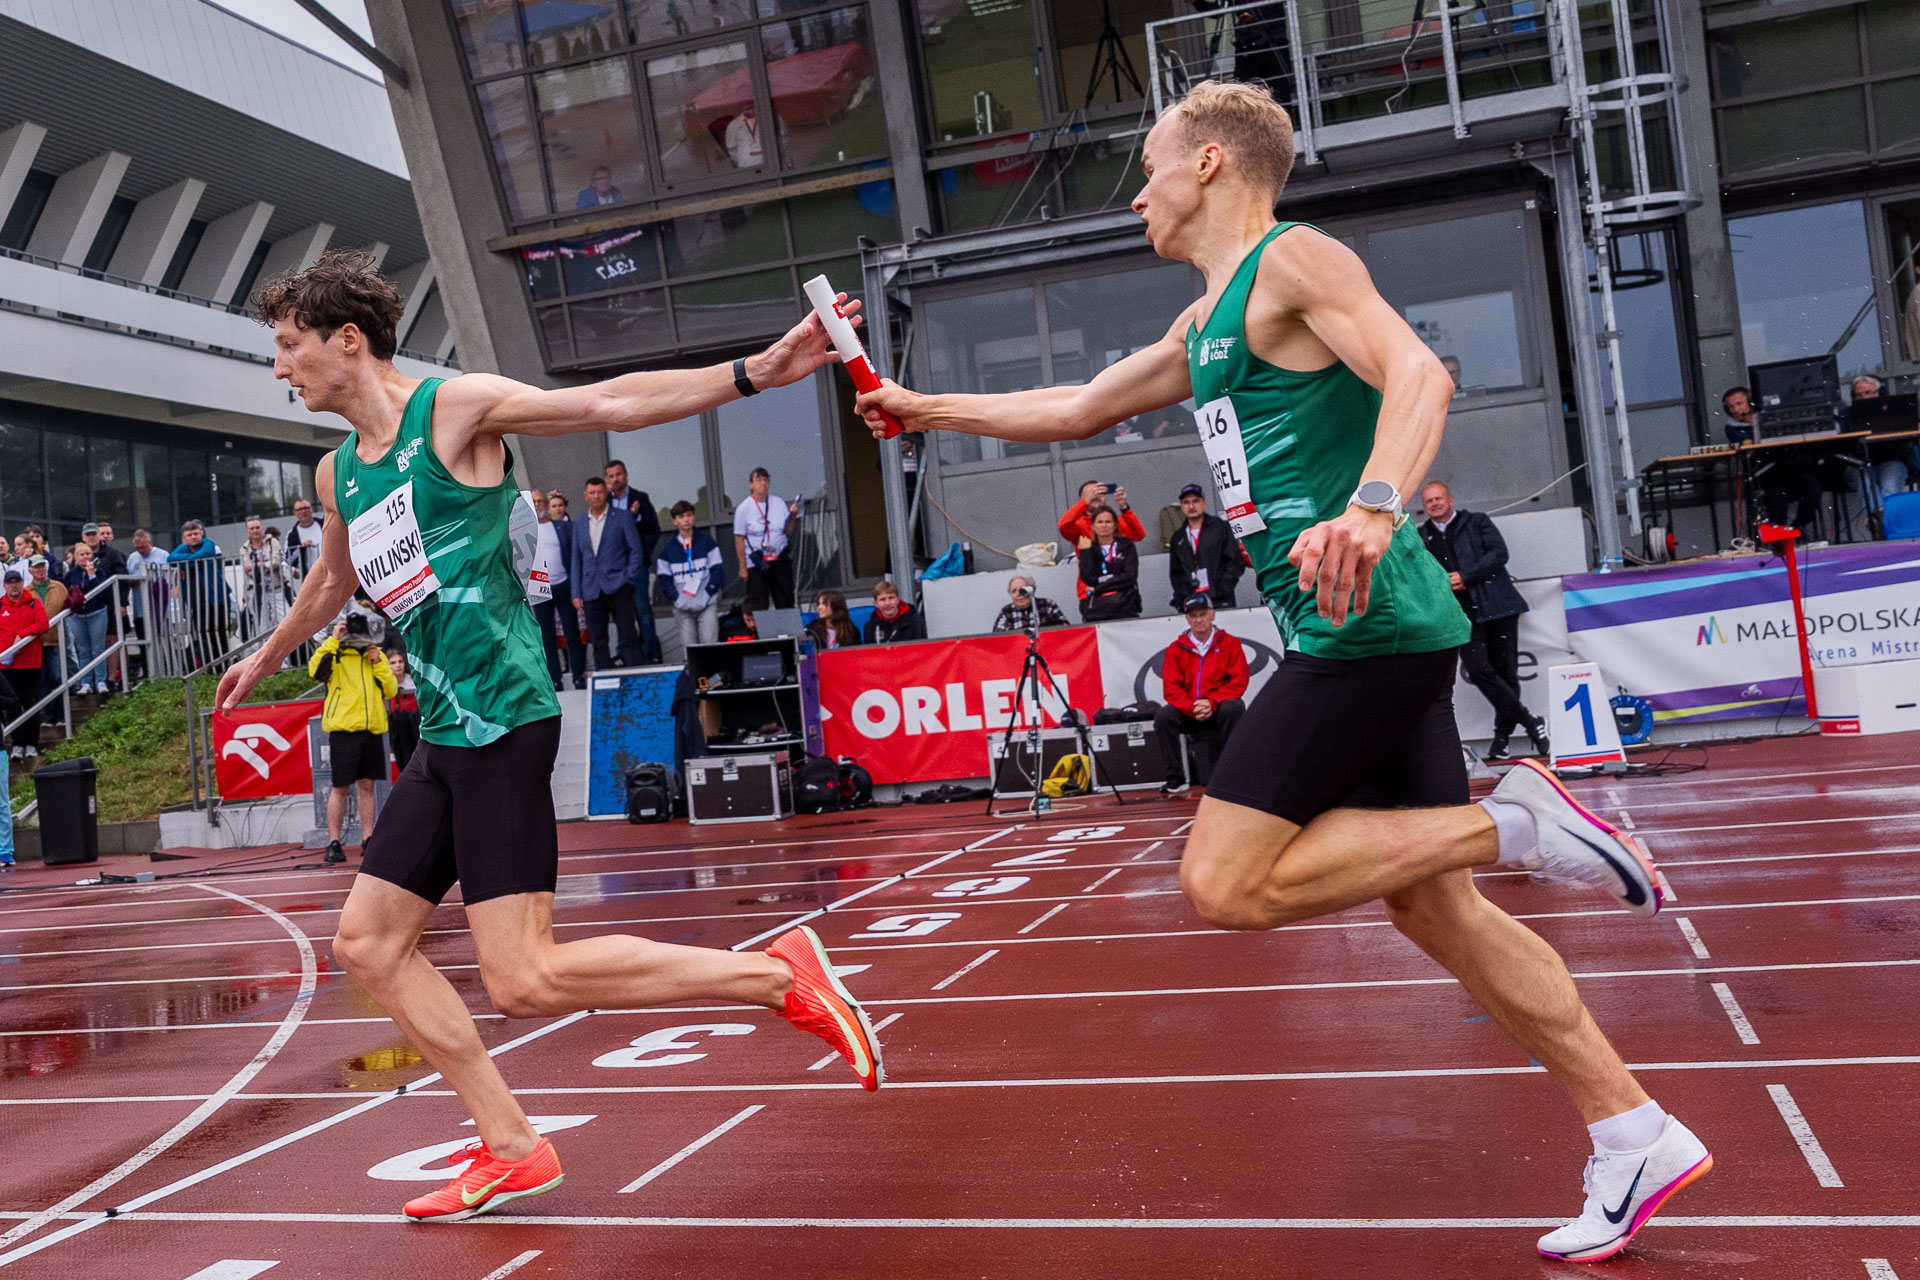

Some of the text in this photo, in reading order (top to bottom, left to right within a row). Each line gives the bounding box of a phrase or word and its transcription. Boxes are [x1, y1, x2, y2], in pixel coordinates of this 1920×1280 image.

[386, 493, 406, 526] 115
[358, 529, 422, 588] WILIŃSKI
[392, 597, 414, 614] KRAKÓW
[851, 674, 1071, 739] ORLEN
[1564, 683, 1597, 746] 1
[1047, 826, 1125, 841] 8
[992, 848, 1077, 867] 7
[932, 876, 1031, 897] 6
[849, 912, 962, 939] 5
[591, 1023, 757, 1068] 3
